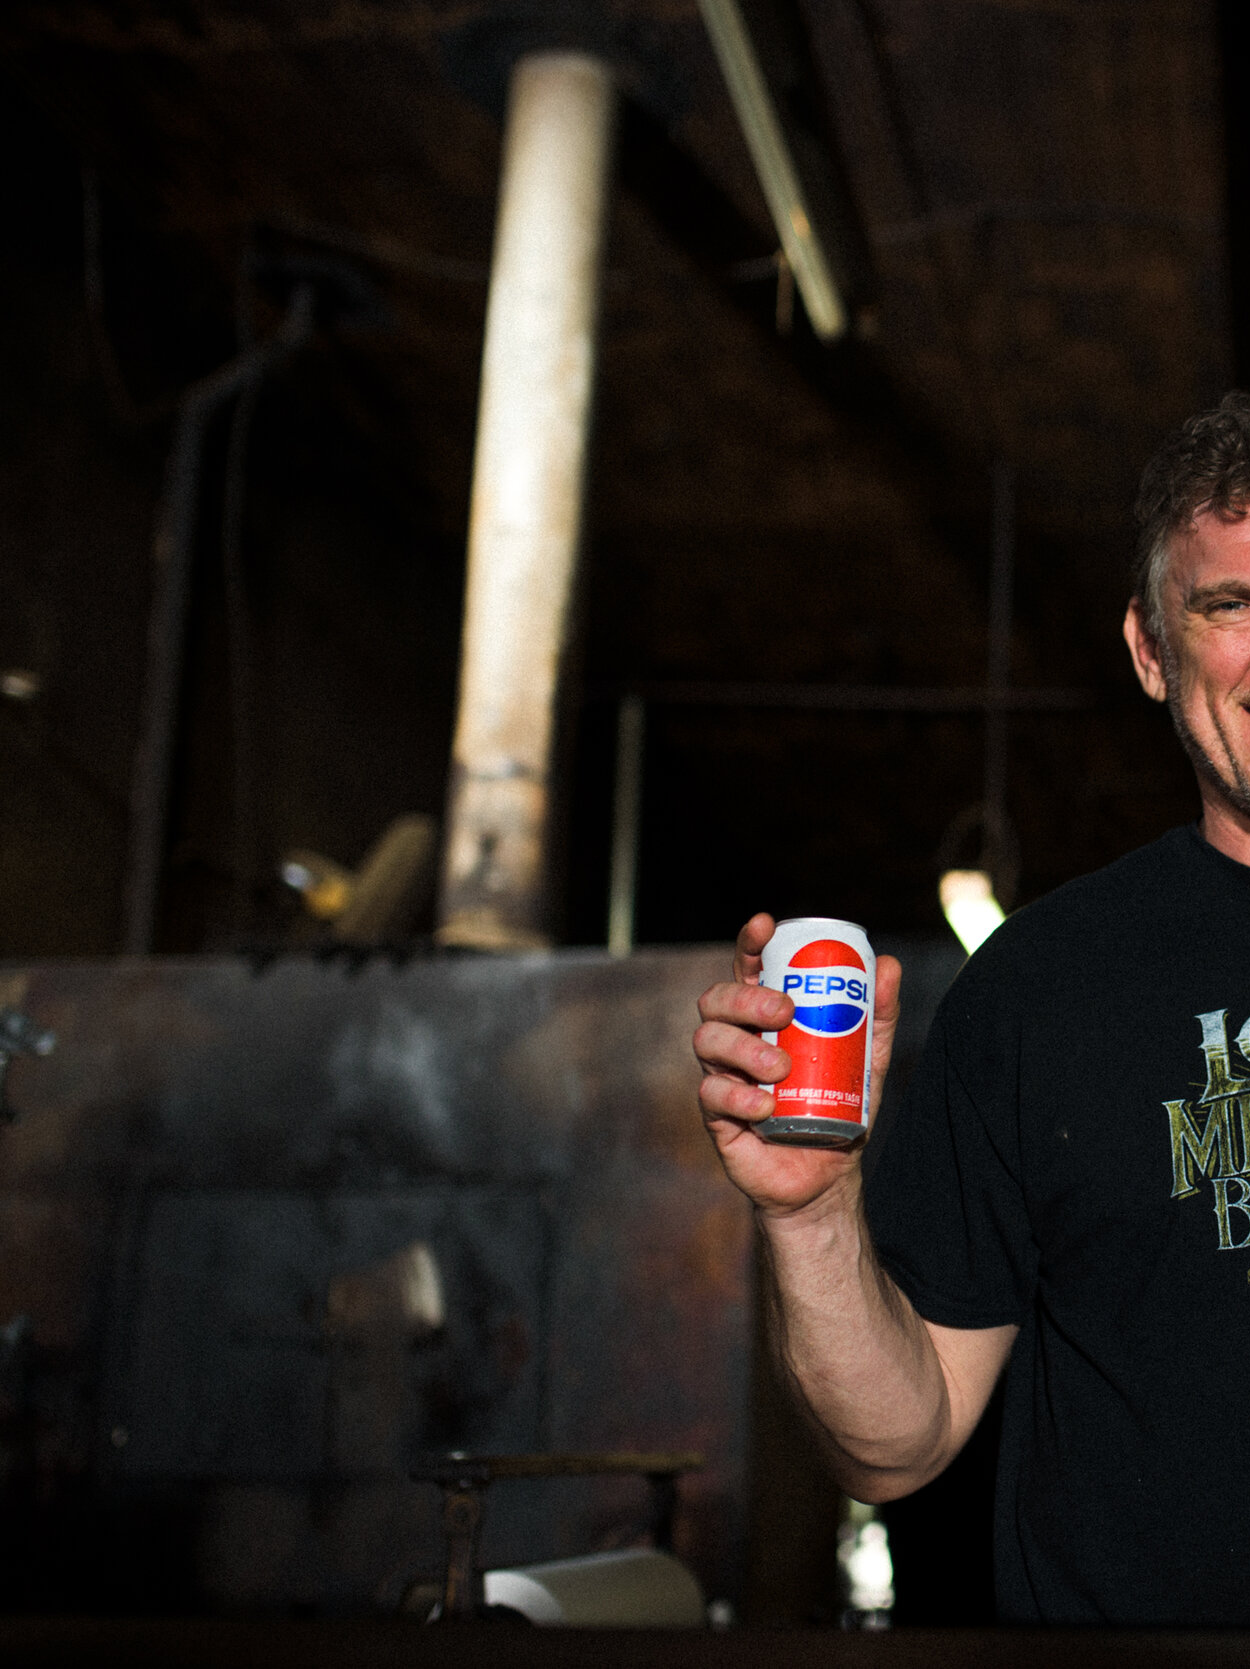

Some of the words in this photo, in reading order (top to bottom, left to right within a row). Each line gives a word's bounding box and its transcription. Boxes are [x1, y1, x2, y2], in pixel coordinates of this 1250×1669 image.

[783, 974, 868, 1003] PEPSI
[777, 1088, 798, 1098] SAME
[799, 1088, 823, 1098] GREAT
[824, 1090, 844, 1101] PEPSI
